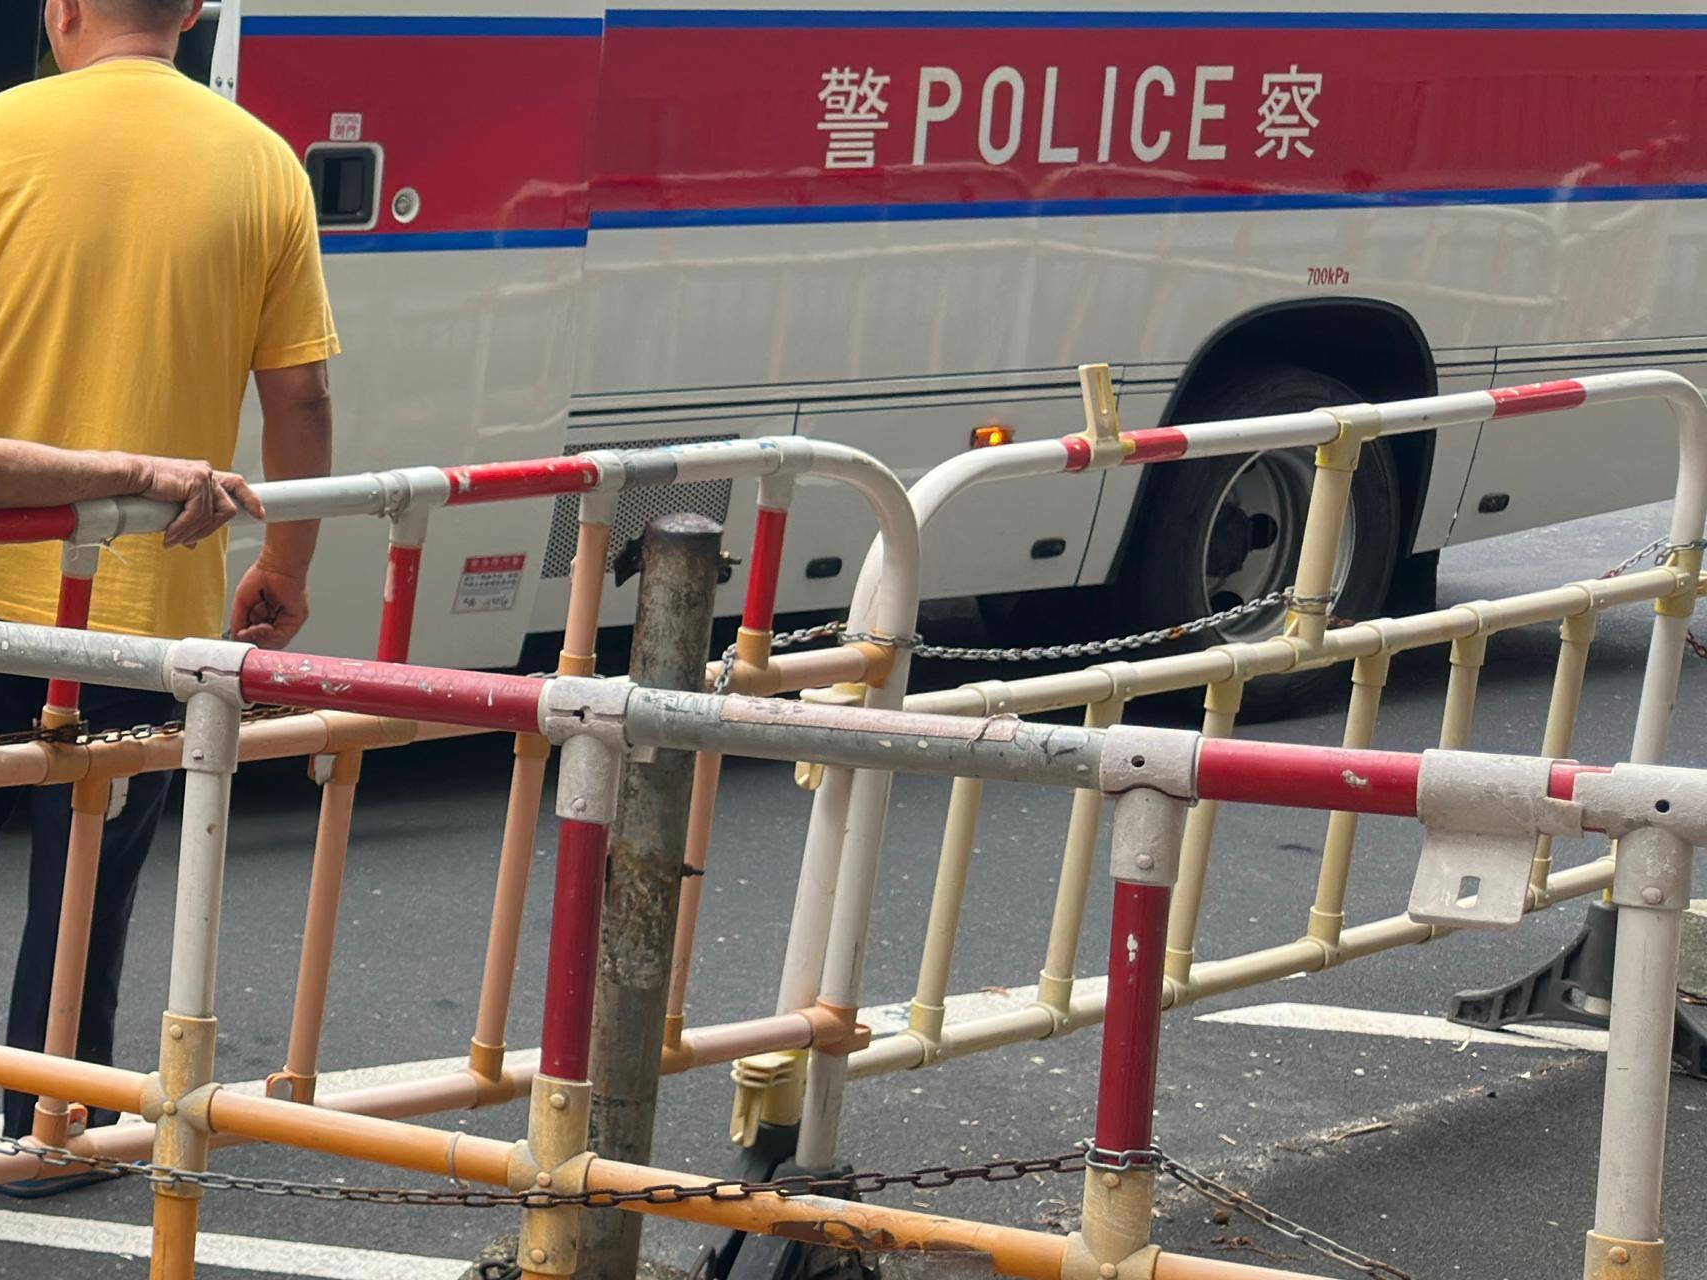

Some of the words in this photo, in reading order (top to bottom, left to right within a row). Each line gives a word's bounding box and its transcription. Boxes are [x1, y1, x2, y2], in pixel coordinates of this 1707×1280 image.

[817, 66, 891, 170] 警
[912, 64, 1236, 166] POLICE
[1255, 64, 1324, 161] 察
[1307, 267, 1350, 286] 700kPa
